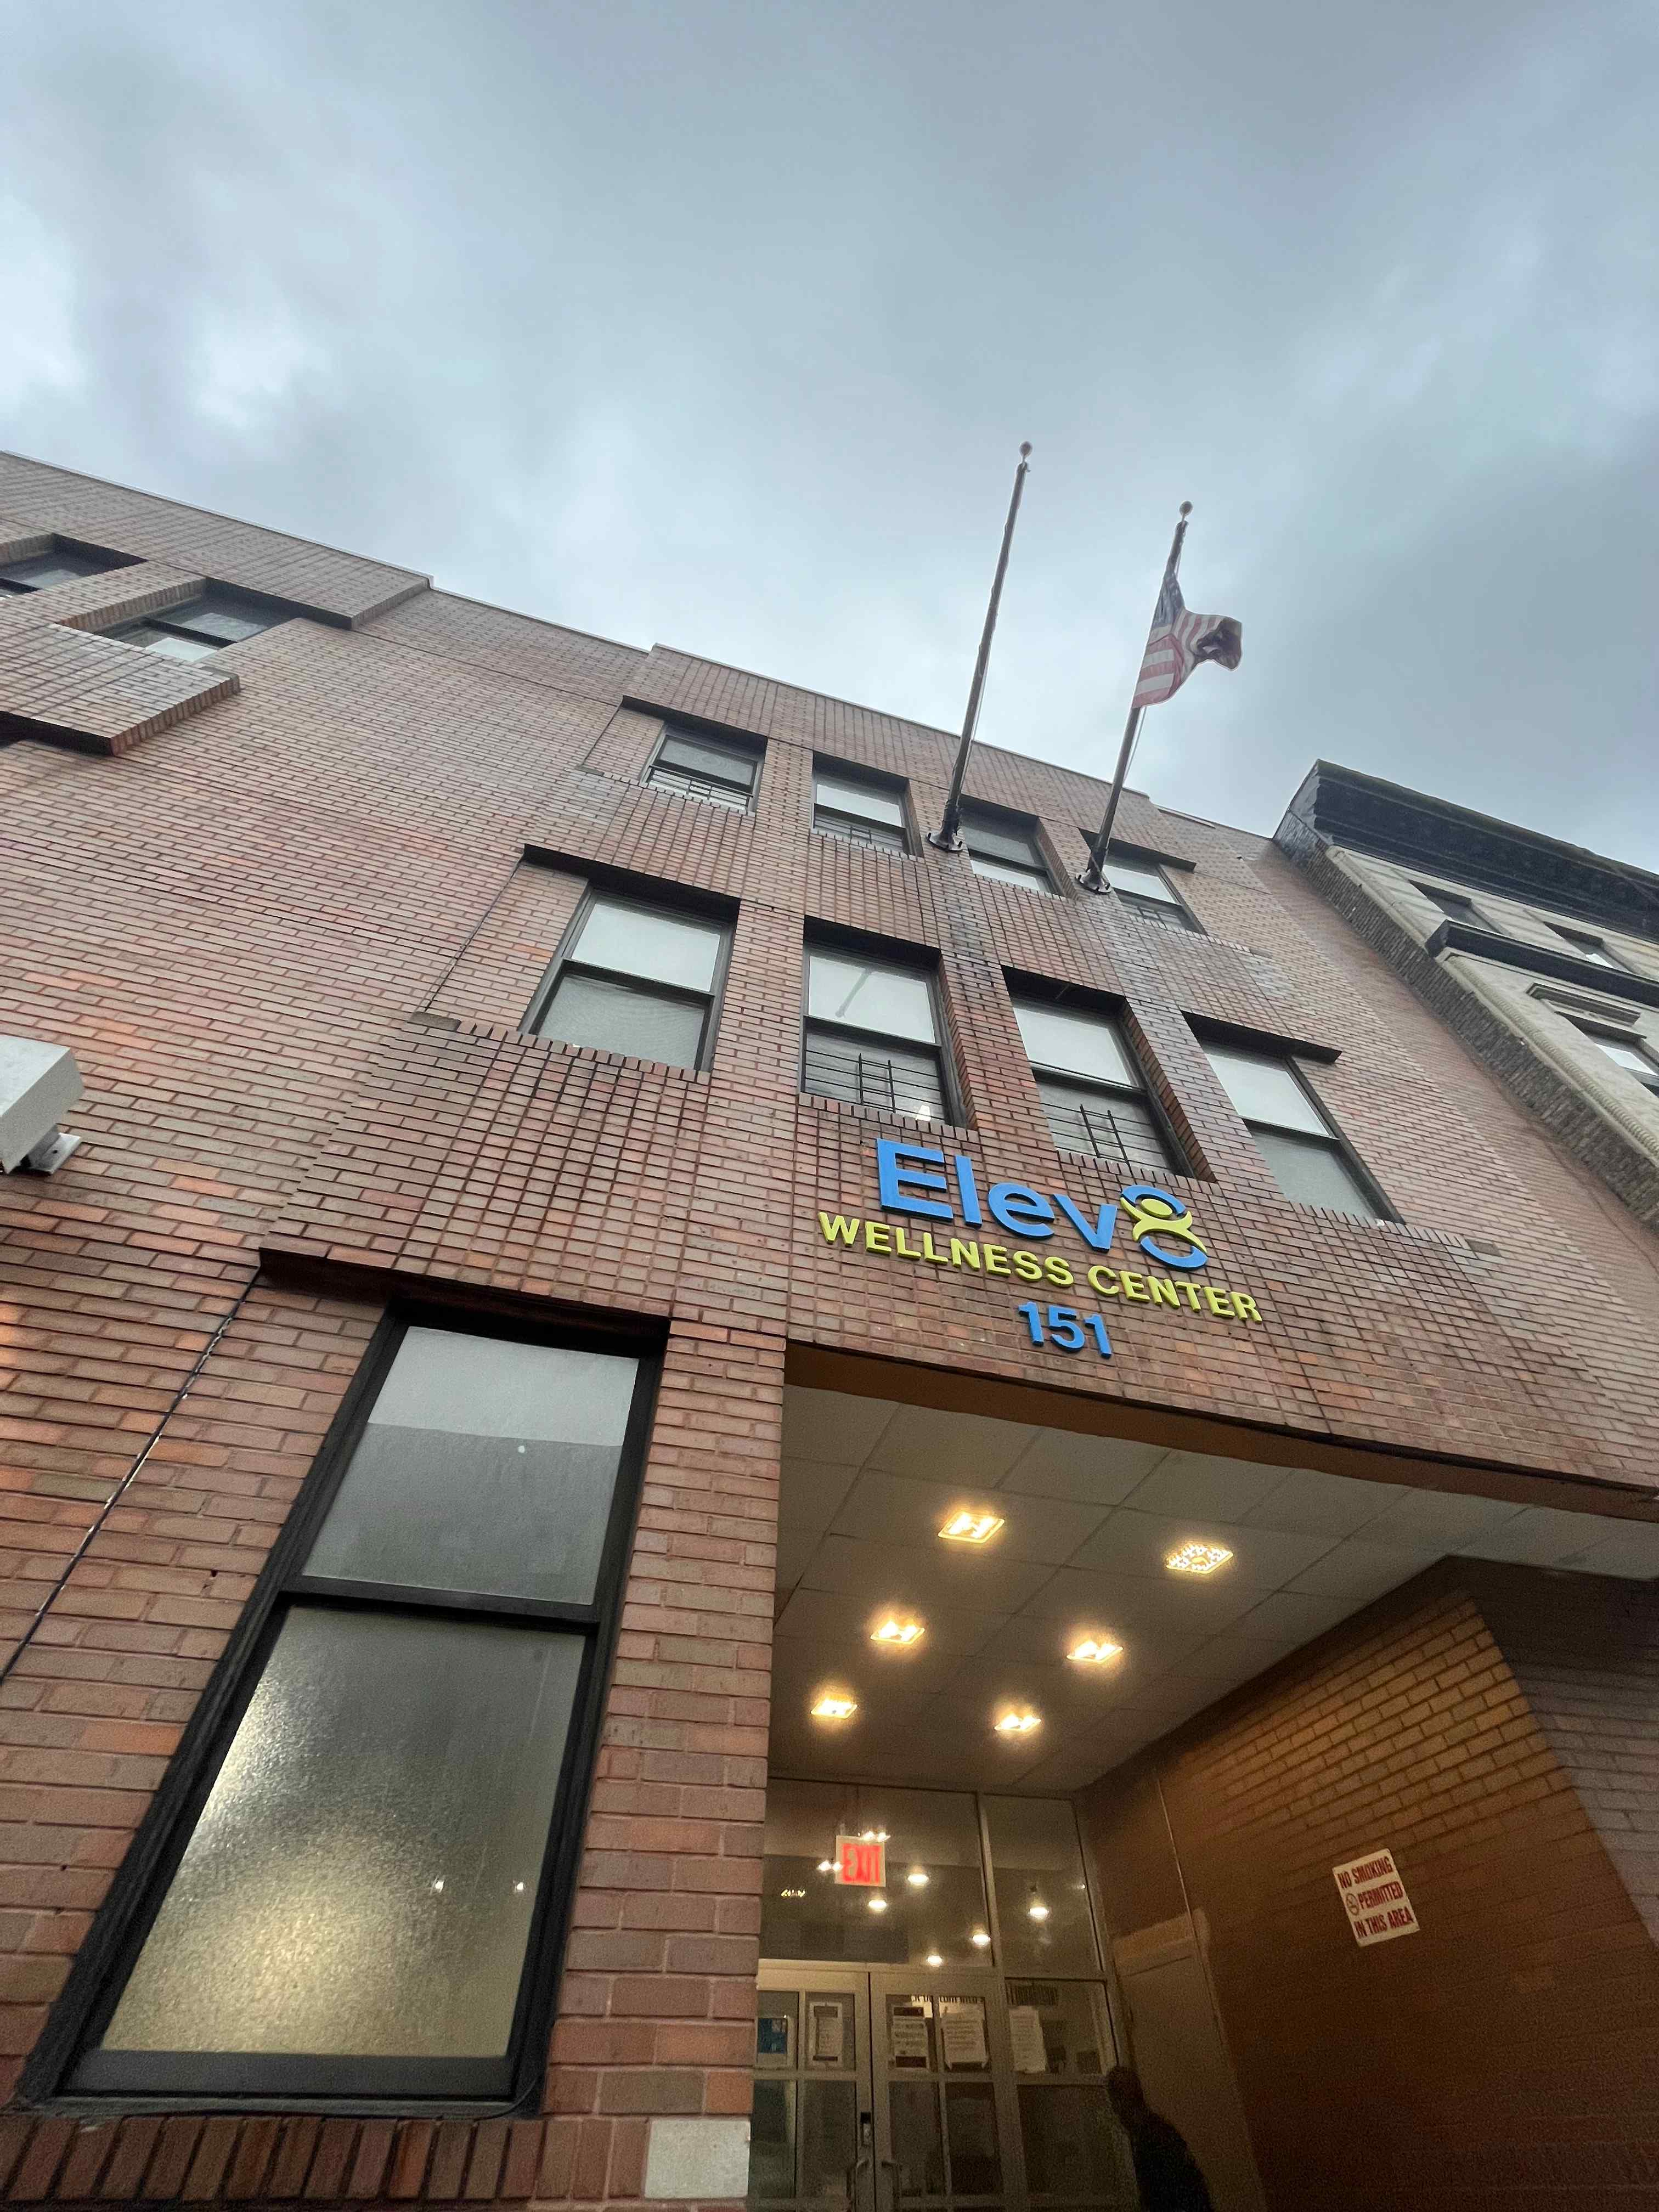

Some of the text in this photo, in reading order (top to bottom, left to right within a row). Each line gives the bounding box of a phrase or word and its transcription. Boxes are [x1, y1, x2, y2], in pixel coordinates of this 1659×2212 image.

[819, 1211, 1263, 1324] WELLNESS CENTER
[1018, 1301, 1113, 1359] 151
[843, 1843, 881, 1883] EXIT
[1337, 1856, 1393, 1889] NO SMOKING
[1357, 1881, 1404, 1910] PERMITTED
[1353, 1907, 1414, 1938] IN THIS AREA
